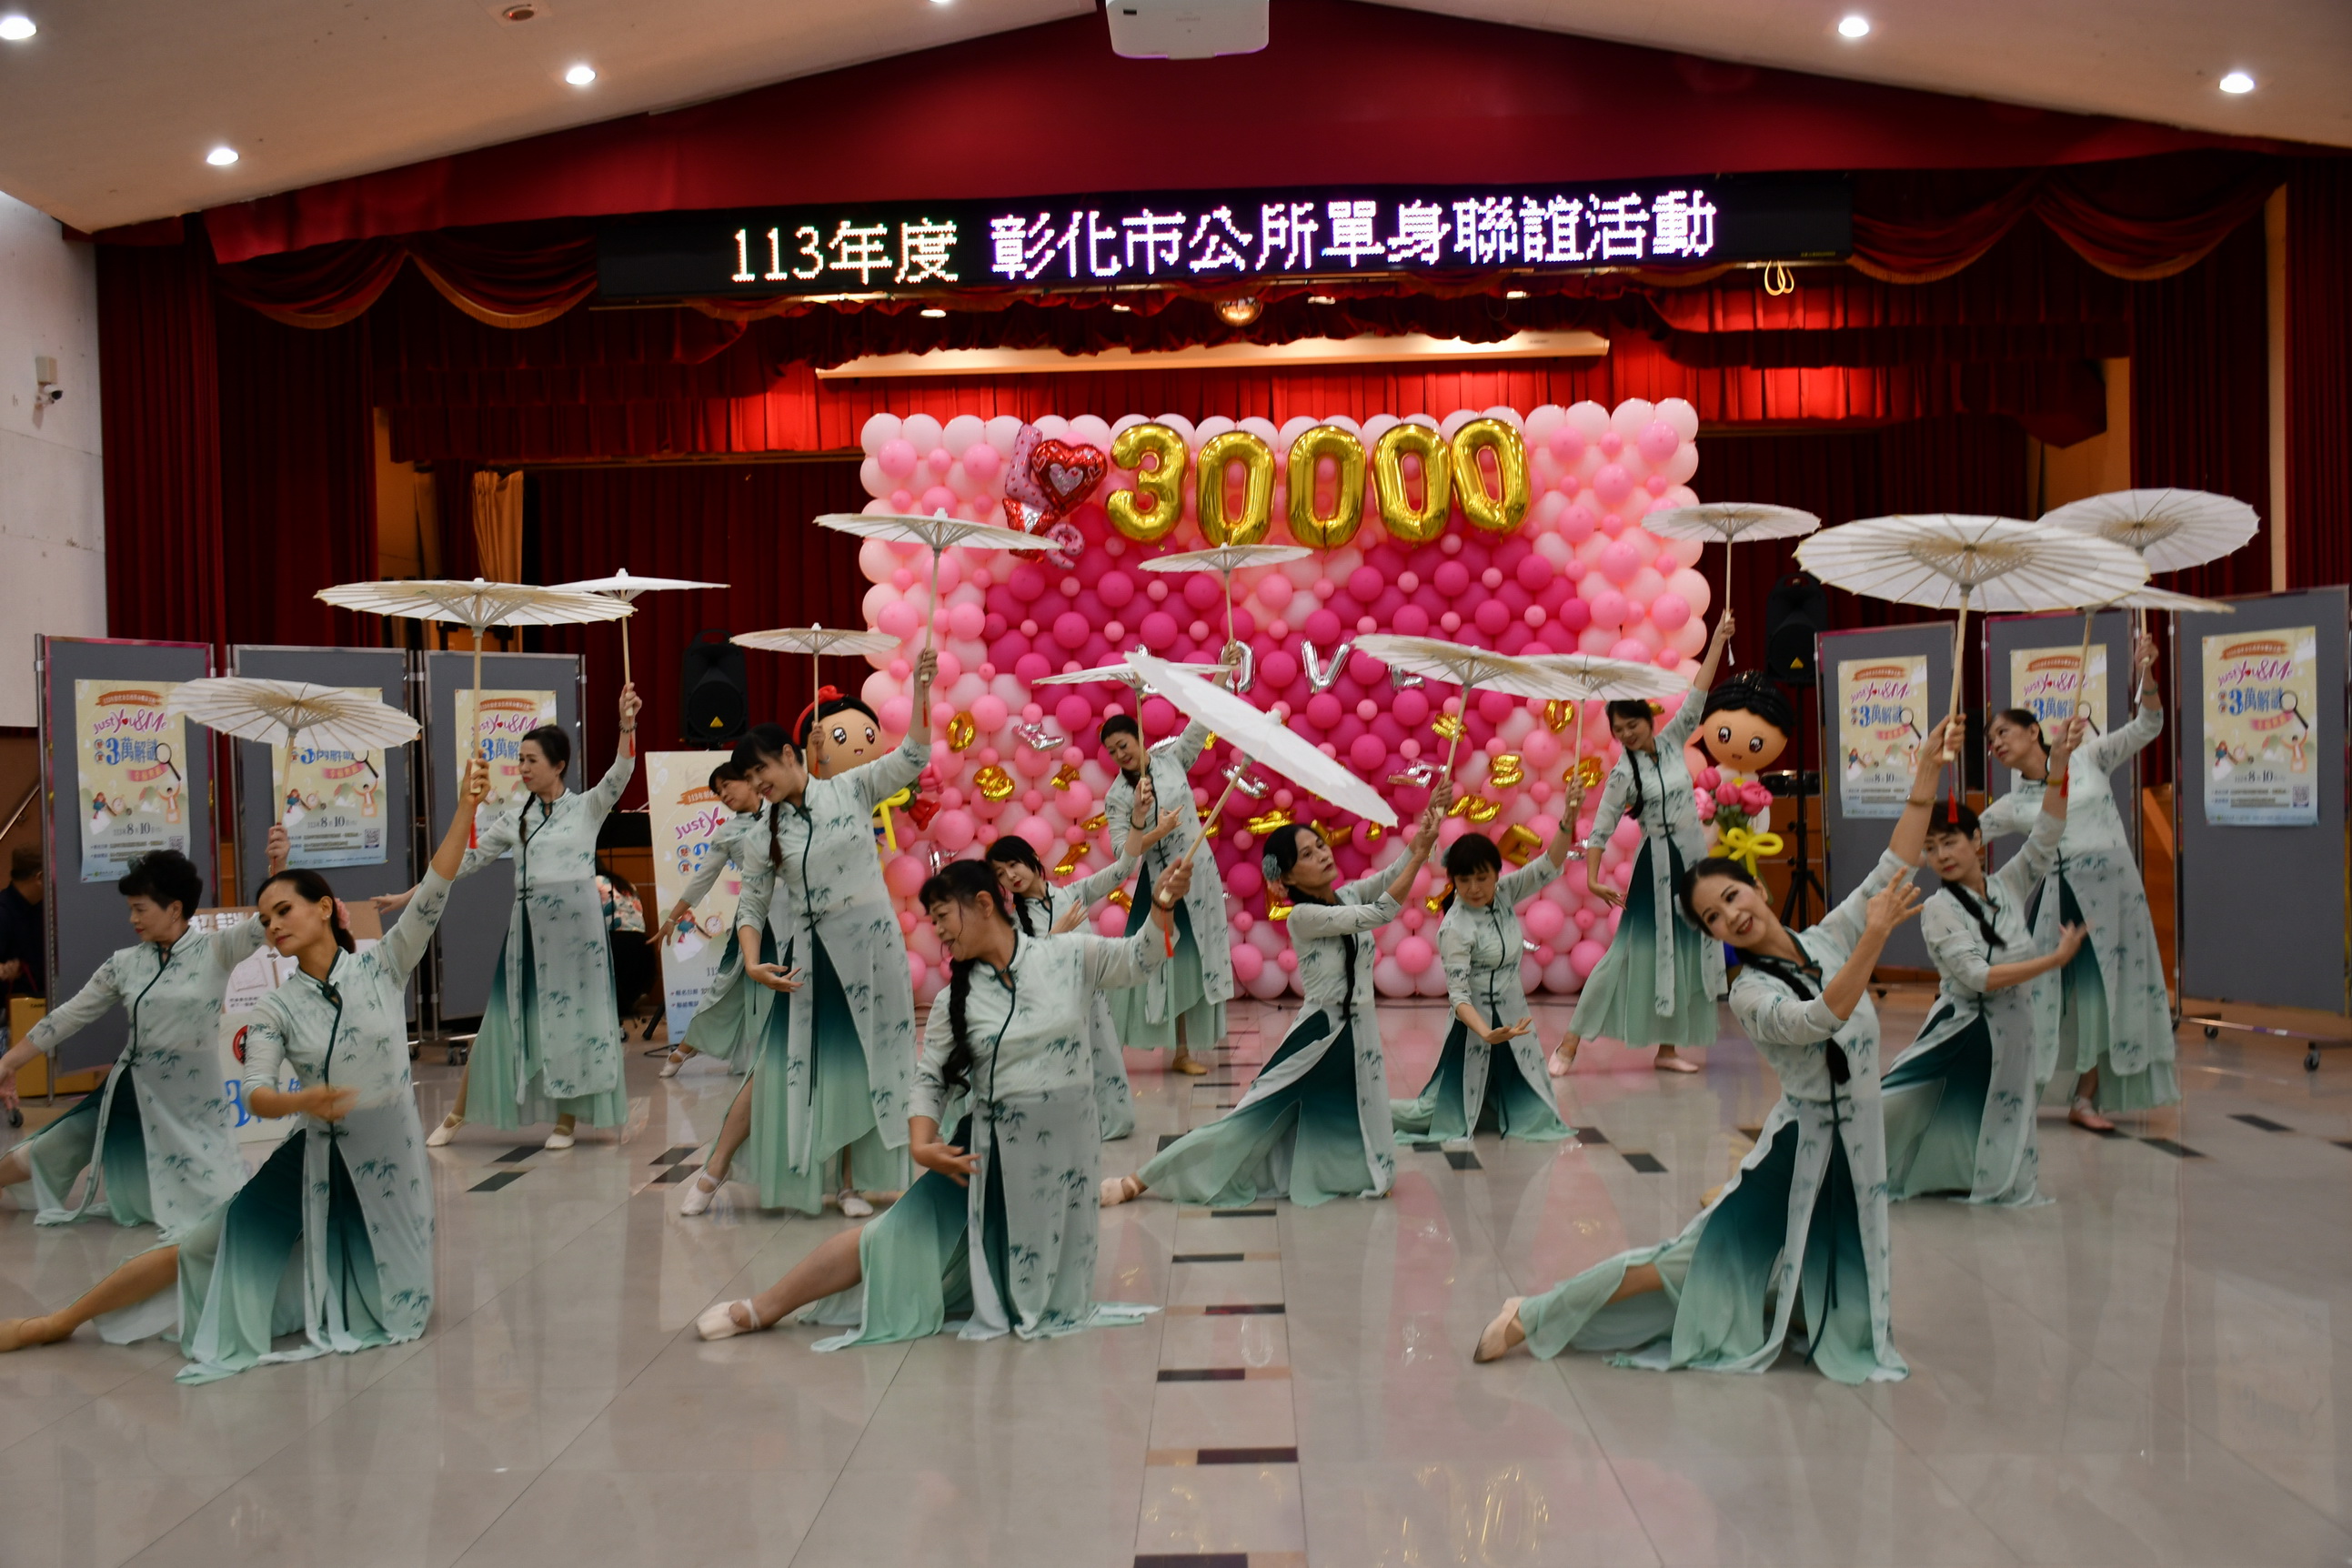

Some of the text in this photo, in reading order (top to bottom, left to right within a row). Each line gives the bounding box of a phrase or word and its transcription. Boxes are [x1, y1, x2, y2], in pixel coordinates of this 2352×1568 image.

[731, 189, 1718, 286] 113年度 彰化市公所單身聯誼活動
[1106, 416, 1533, 551] 30000
[94, 717, 116, 735] Just
[675, 816, 706, 839] Just
